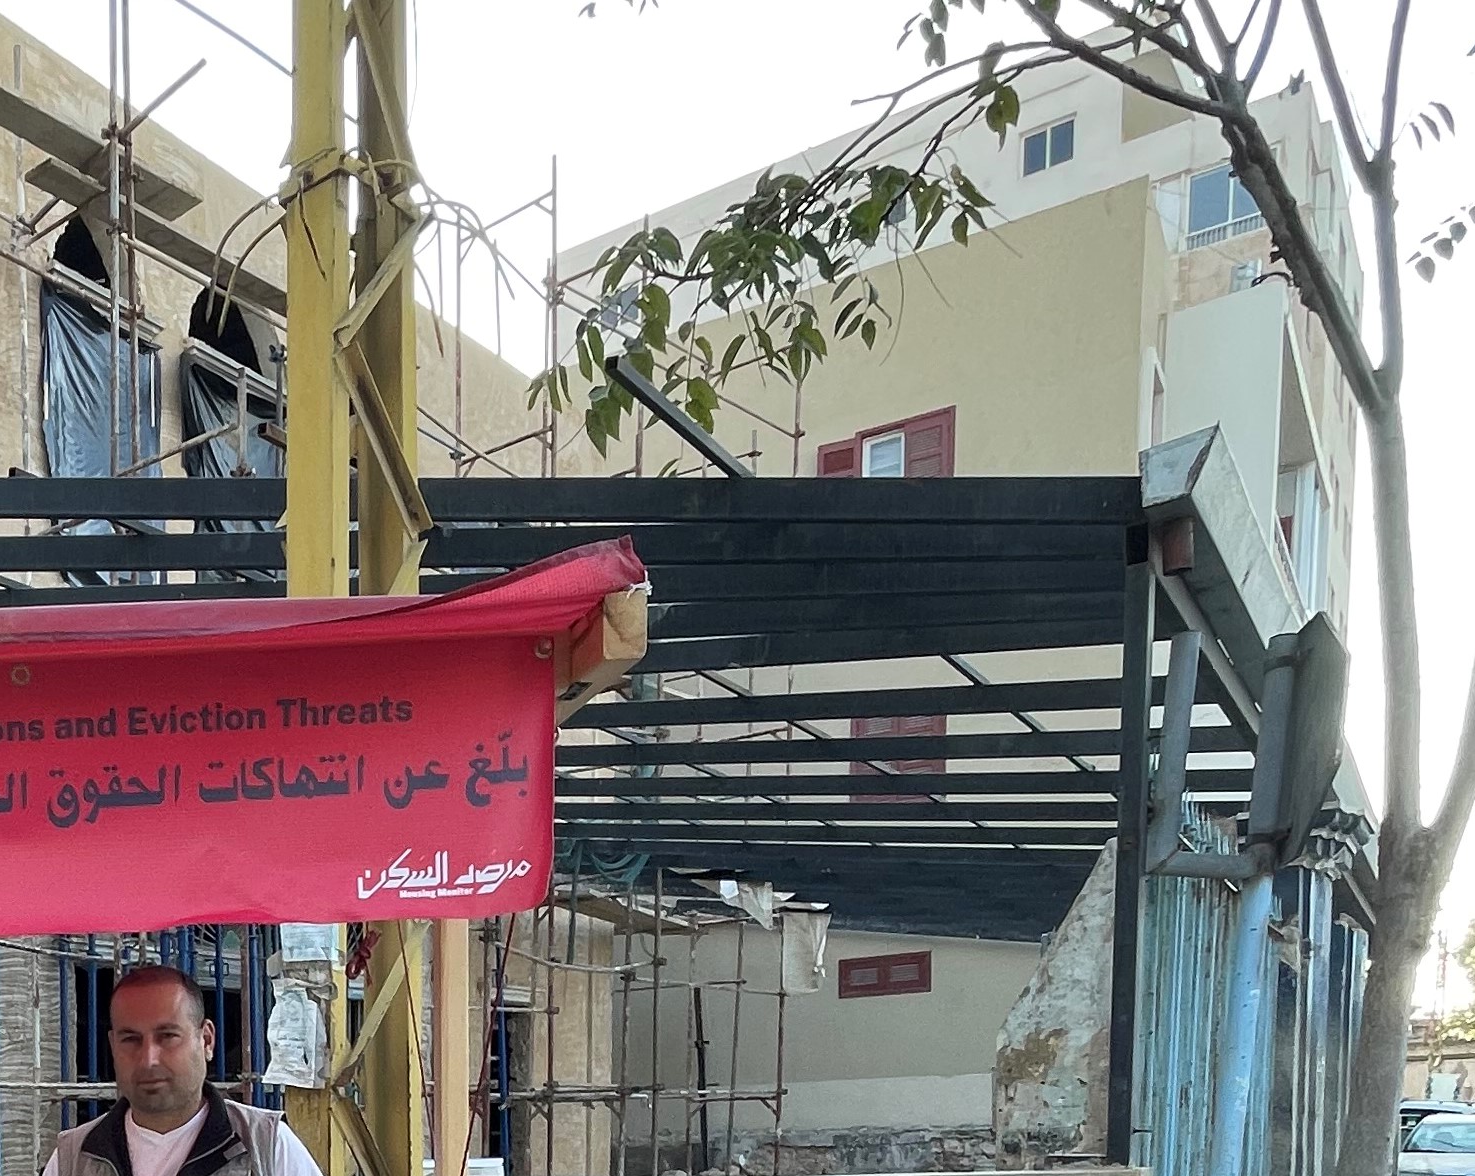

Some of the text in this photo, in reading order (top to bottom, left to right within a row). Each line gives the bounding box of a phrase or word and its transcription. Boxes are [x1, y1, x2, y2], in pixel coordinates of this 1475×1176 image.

[54, 707, 118, 740] and
[128, 702, 267, 736] Eviction
[277, 696, 414, 728] Threats
[46, 763, 182, 829] الحقوق
[198, 754, 365, 804] انتهاكات
[383, 760, 450, 810] عن
[357, 847, 532, 900] مرصد السكن
[399, 886, 475, 900] Housing Monitor
